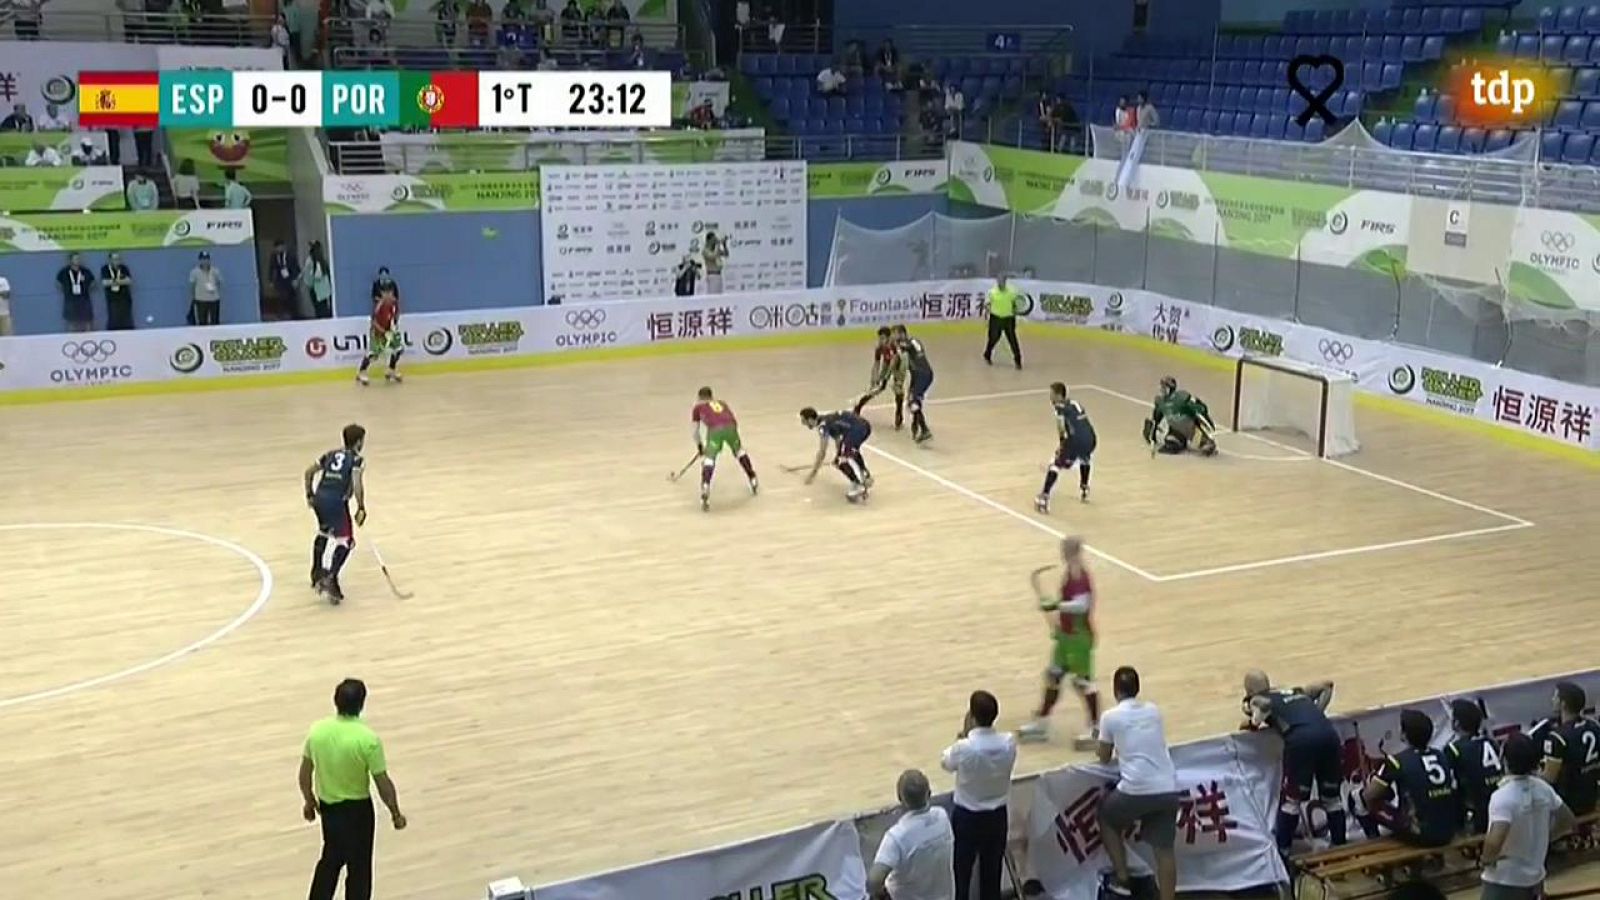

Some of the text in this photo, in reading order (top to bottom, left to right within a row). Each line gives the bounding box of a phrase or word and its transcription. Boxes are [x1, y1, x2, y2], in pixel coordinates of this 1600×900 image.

[206, 220, 243, 230] FIRS
[1360, 219, 1397, 234] FIRS
[1449, 209, 1460, 225] C
[1529, 251, 1580, 270] OLYMPIC
[646, 306, 733, 341] 恒源祥
[555, 331, 617, 347] OLYMPIC
[50, 364, 133, 383] OLYMPIC
[1492, 385, 1593, 443] 恒源祥
[331, 452, 346, 471] 3
[1482, 741, 1502, 771] 4
[1581, 730, 1599, 763] 2
[1421, 754, 1446, 785] 5
